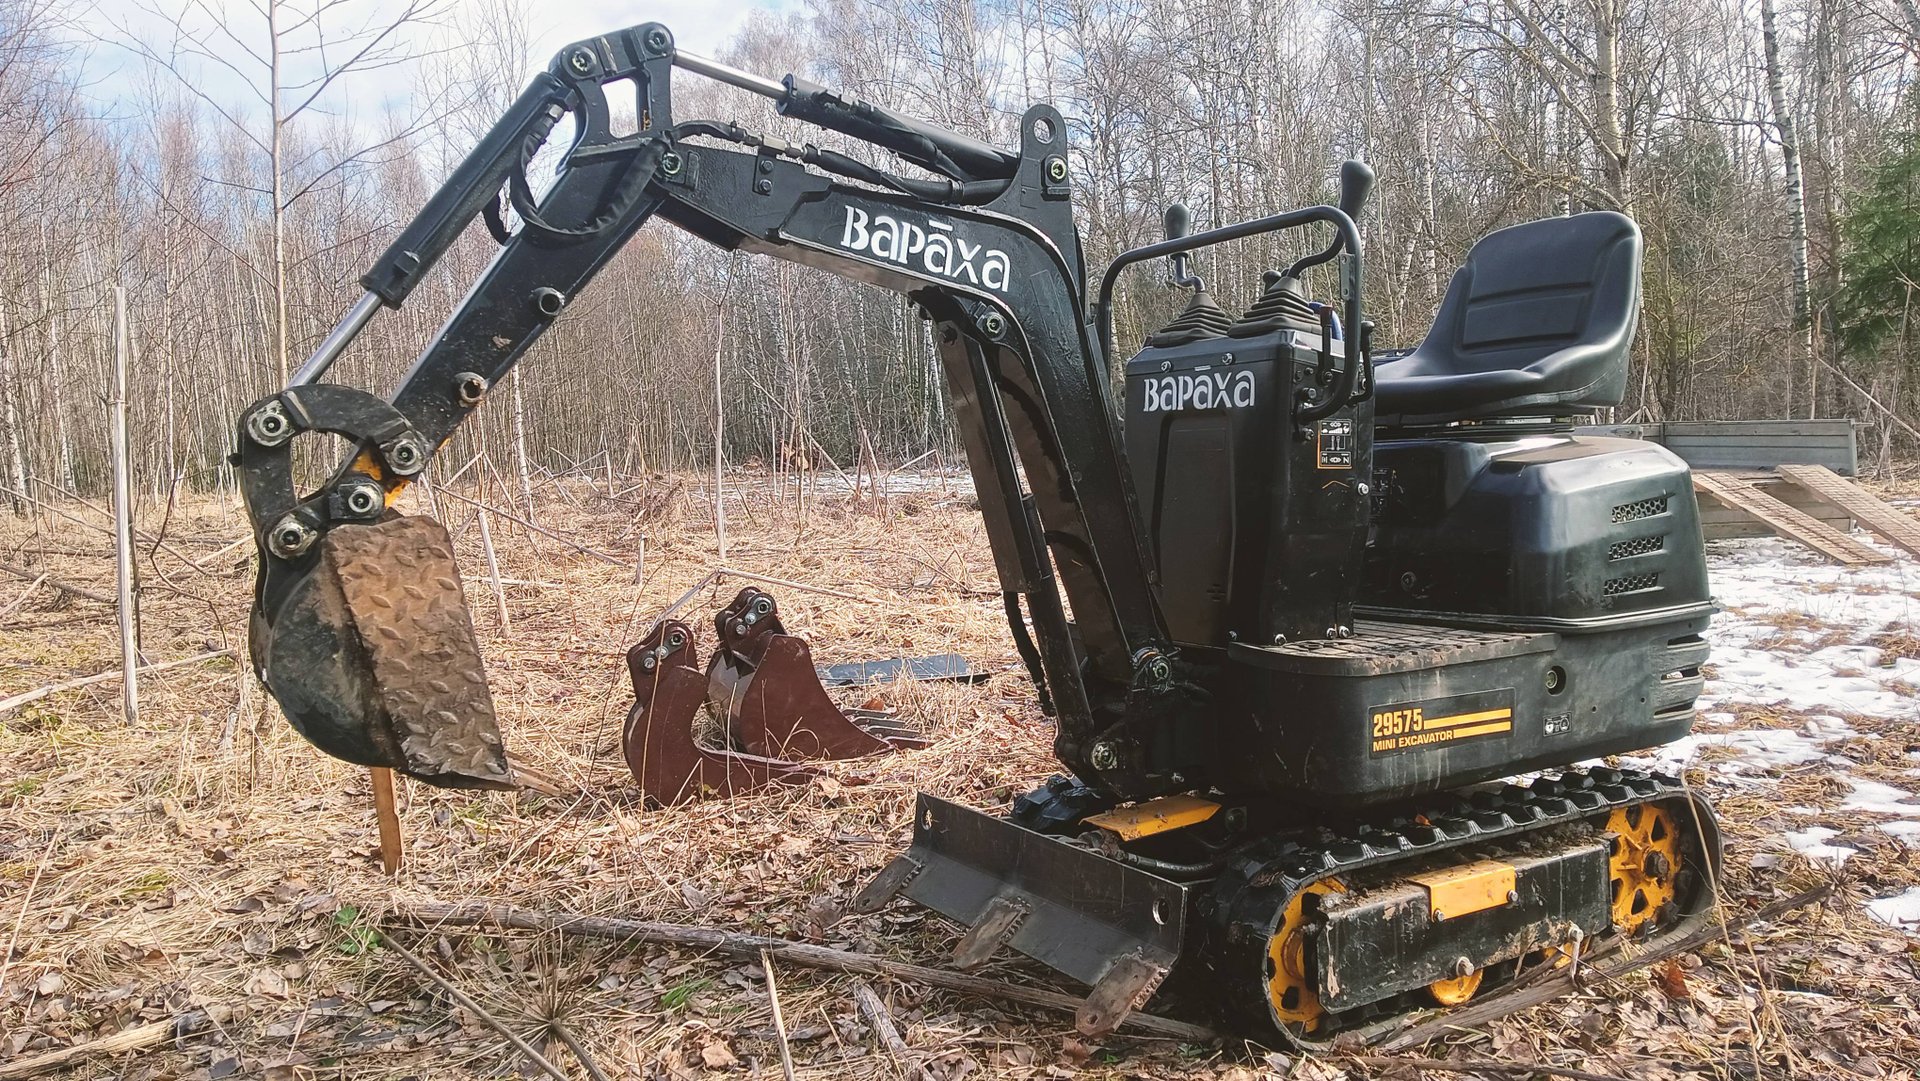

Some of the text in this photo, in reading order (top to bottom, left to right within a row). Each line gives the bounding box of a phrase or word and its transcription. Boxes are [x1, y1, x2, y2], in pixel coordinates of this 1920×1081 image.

[1373, 708, 1422, 738] 29575
[1373, 730, 1453, 752] MINI EXCAVATOR
